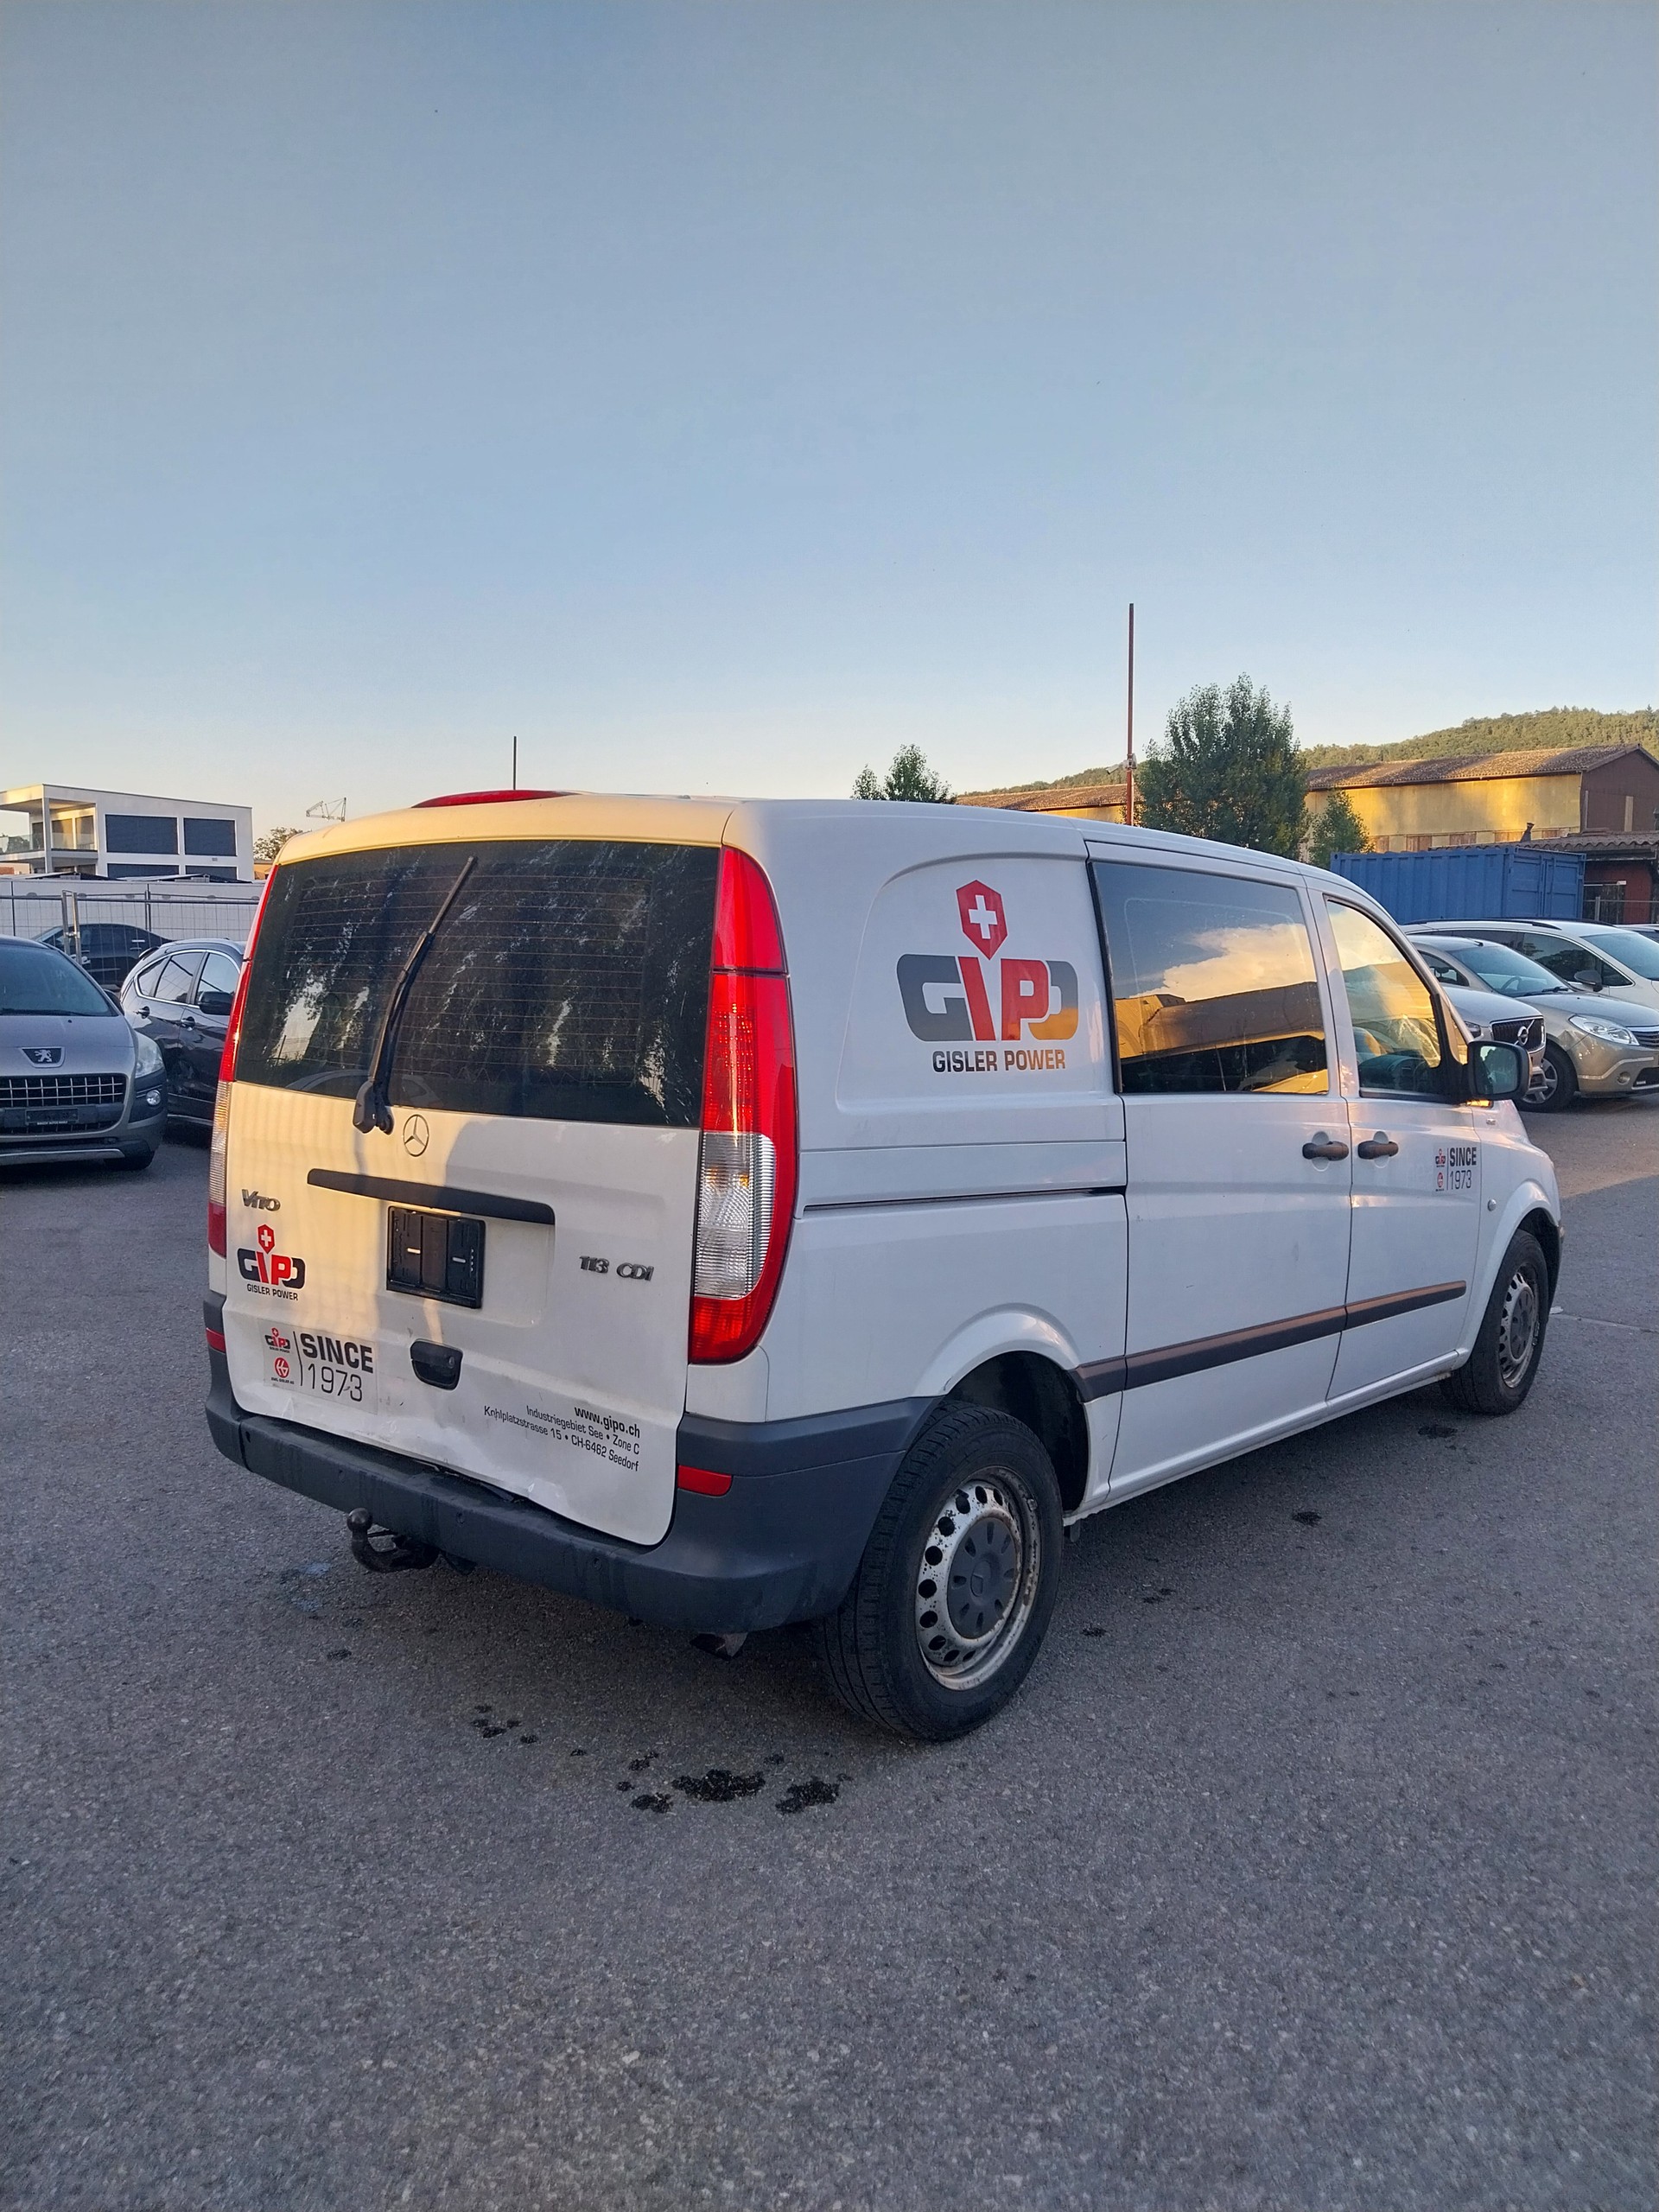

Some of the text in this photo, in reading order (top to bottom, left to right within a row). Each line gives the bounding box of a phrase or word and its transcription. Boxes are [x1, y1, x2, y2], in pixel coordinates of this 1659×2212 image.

[932, 1049, 1065, 1072] GISLER POWER
[1450, 1147, 1477, 1166] SINCE
[1450, 1169, 1471, 1190] 1973
[579, 1255, 610, 1274] 113
[247, 1283, 298, 1300] GISLER POWER
[300, 1332, 374, 1374] SINCE
[308, 1363, 362, 1402] 1973
[526, 1405, 639, 1455] Industriegebiet See Zone C
[575, 1407, 640, 1438] www.gipo.ch
[550, 1427, 562, 1440] 15
[571, 1434, 607, 1458] CH-6462
[608, 1450, 639, 1471] Seedorf
